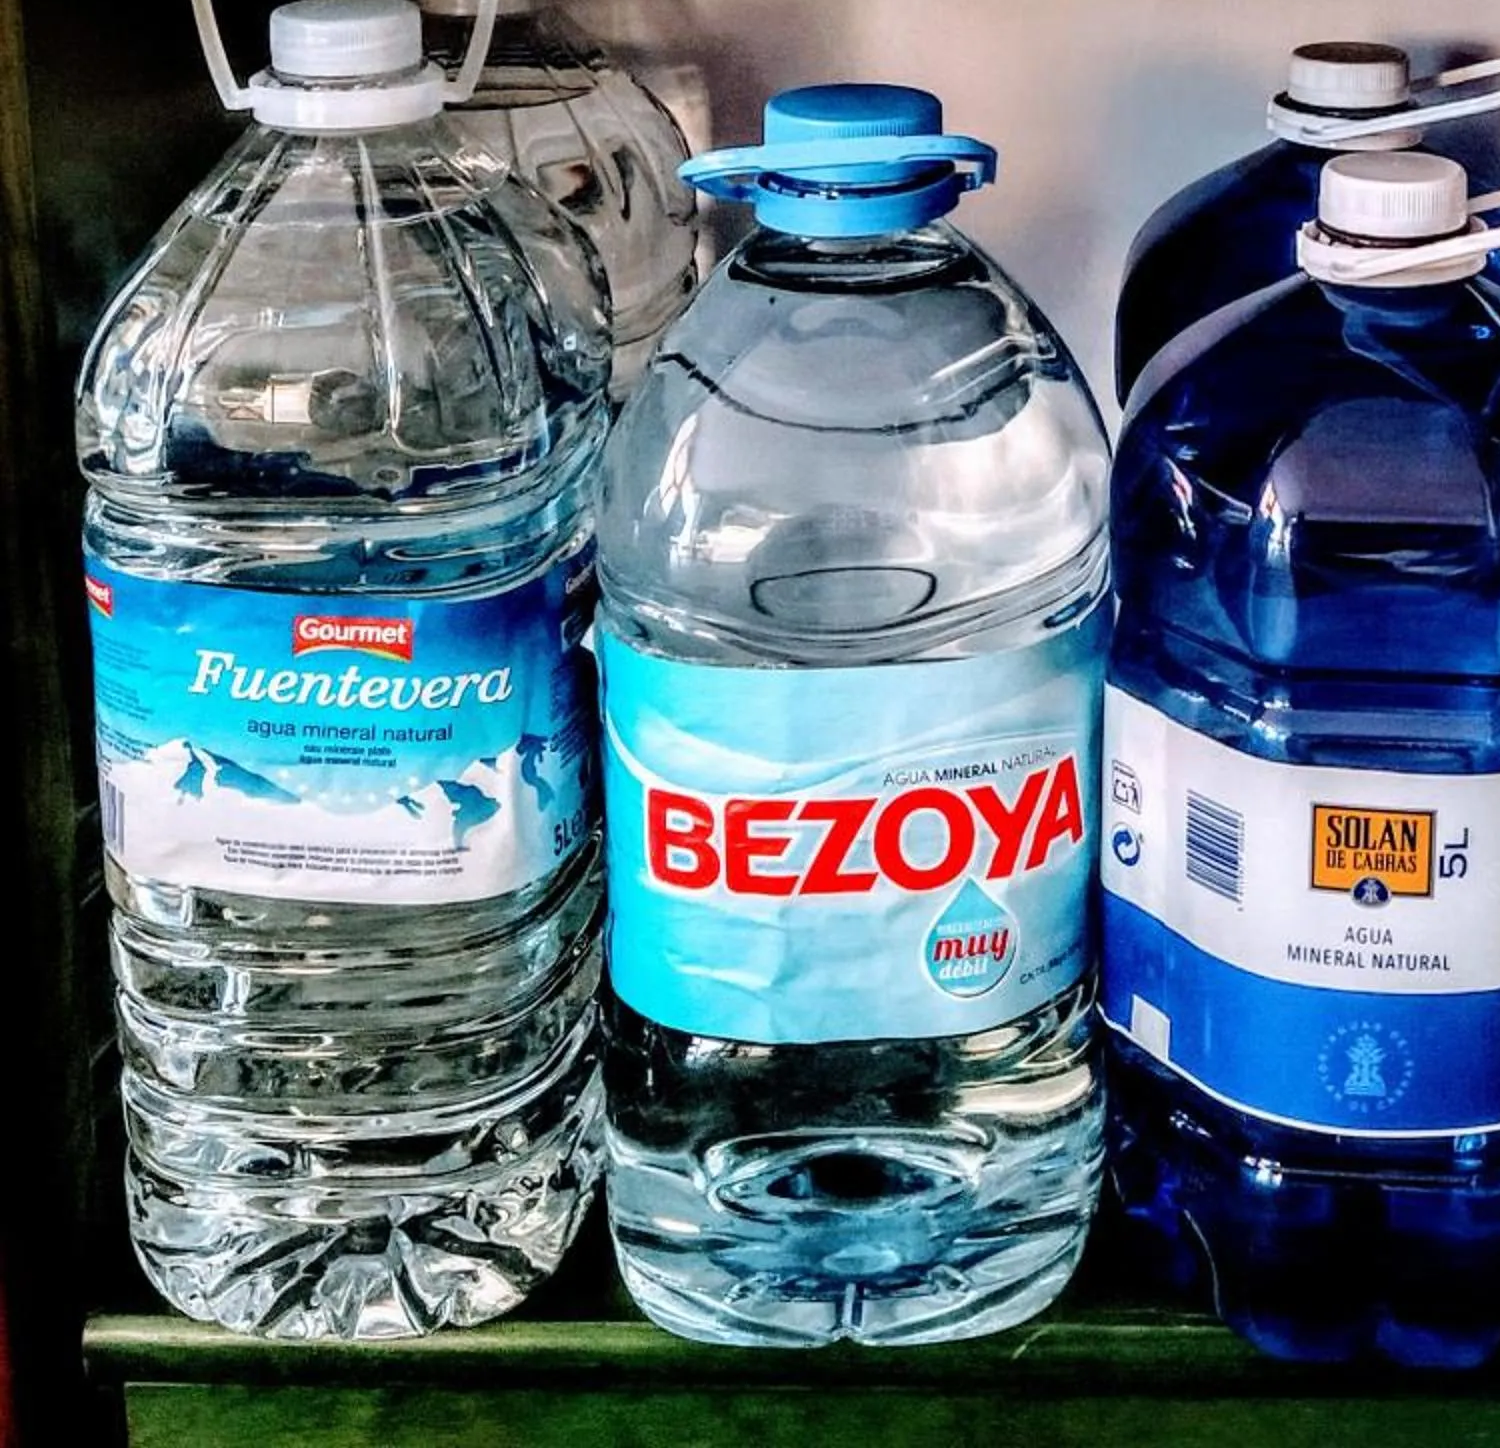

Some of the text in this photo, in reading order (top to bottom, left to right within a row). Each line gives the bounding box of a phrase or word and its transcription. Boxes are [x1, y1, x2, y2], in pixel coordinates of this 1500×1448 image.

[298, 618, 407, 644] Gourmet
[188, 649, 513, 711] Fuentevera
[247, 720, 453, 742] agua mineral natural
[883, 747, 1056, 787] AGUA MINERAL NATURAL
[648, 755, 1085, 897] BEZOYA
[1326, 849, 1418, 874] DE CABRAS
[1439, 827, 1469, 879] 5L
[933, 928, 1009, 962] muy
[1344, 925, 1393, 946] AGUA
[939, 958, 988, 980] débil
[1287, 944, 1451, 972] MINERAL NATURAL
